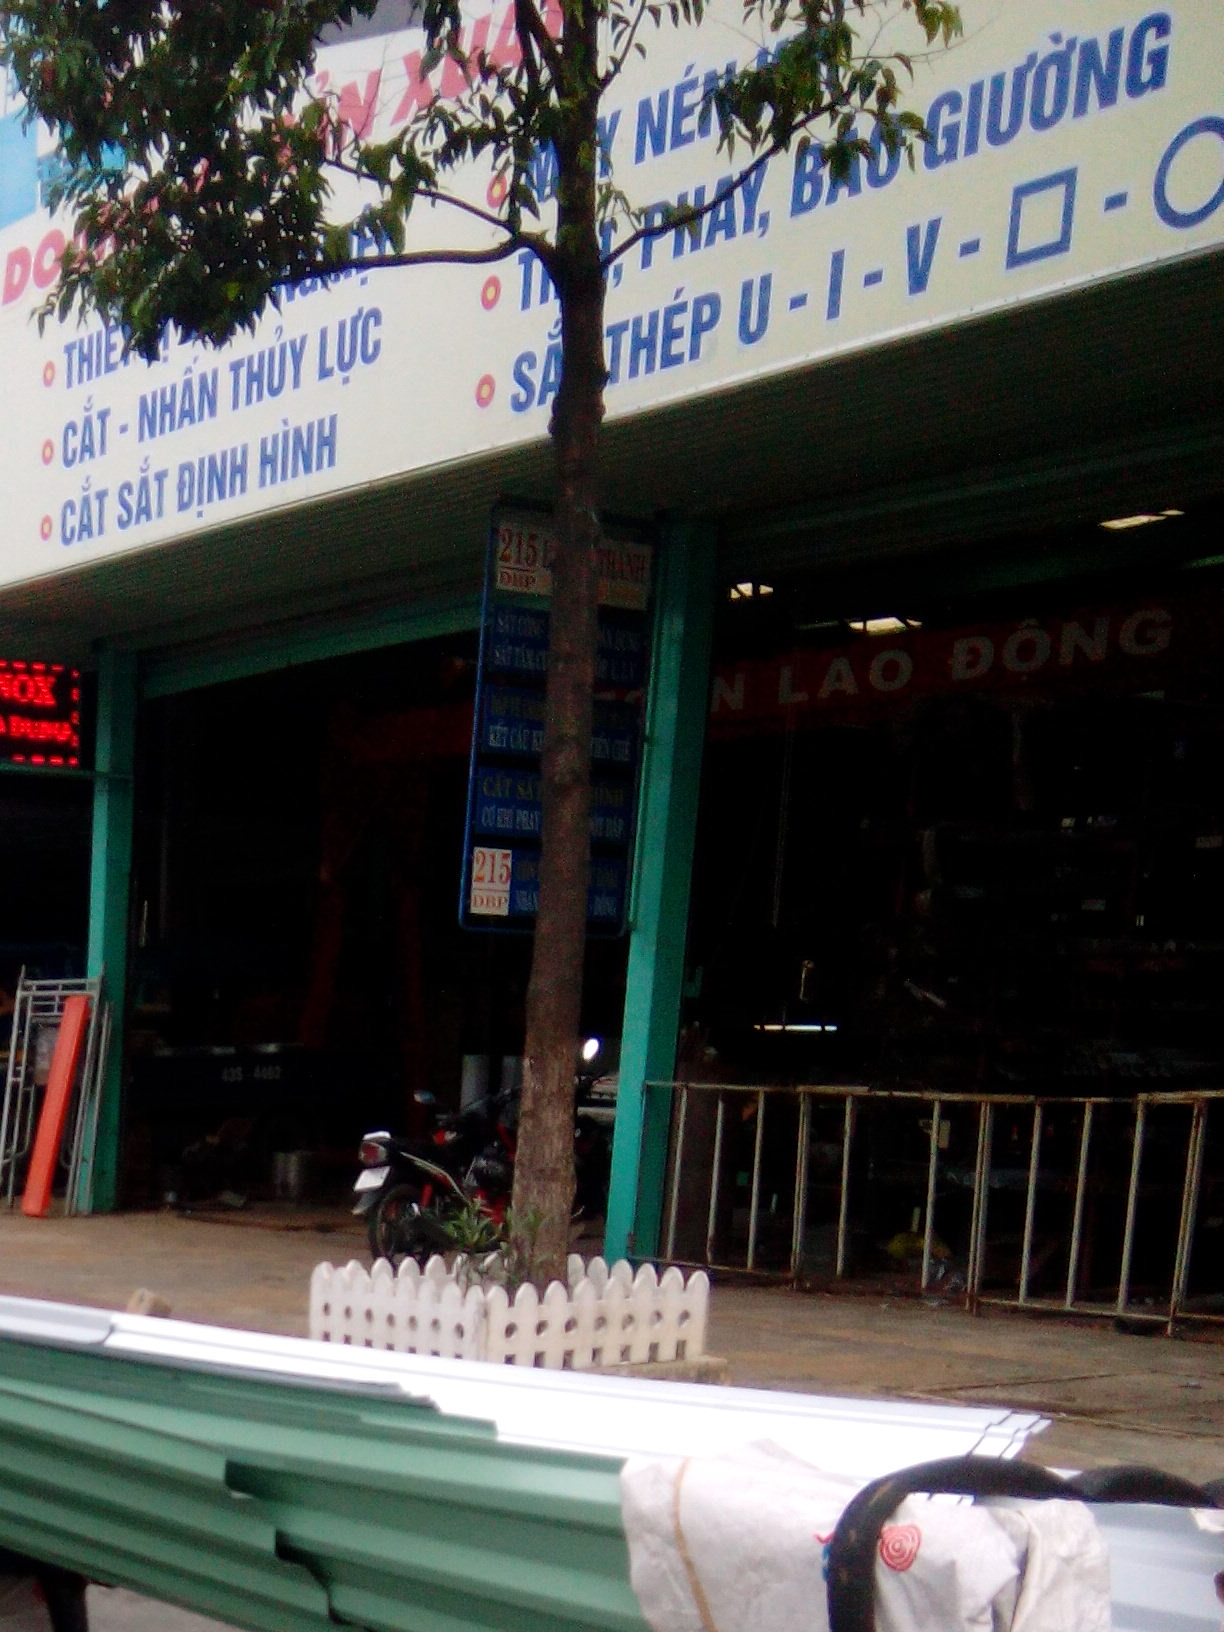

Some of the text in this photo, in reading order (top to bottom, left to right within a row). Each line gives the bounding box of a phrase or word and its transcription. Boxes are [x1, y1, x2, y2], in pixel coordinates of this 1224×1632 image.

[923, 11, 1172, 172] GIƯỜNG
[605, 286, 722, 386] THÉP
[738, 273, 773, 346] U
[906, 217, 943, 296] V
[62, 395, 111, 468] CẮT
[138, 355, 219, 443] NHẤN
[229, 324, 308, 411] THỦY
[317, 306, 383, 386] LỰC
[60, 413, 338, 547] CẮT SẮT ĐỊNH HÌNH
[499, 528, 538, 567] 215
[778, 648, 914, 706] LAO
[949, 607, 1173, 683] ĐỘNG
[473, 850, 511, 885] 215
